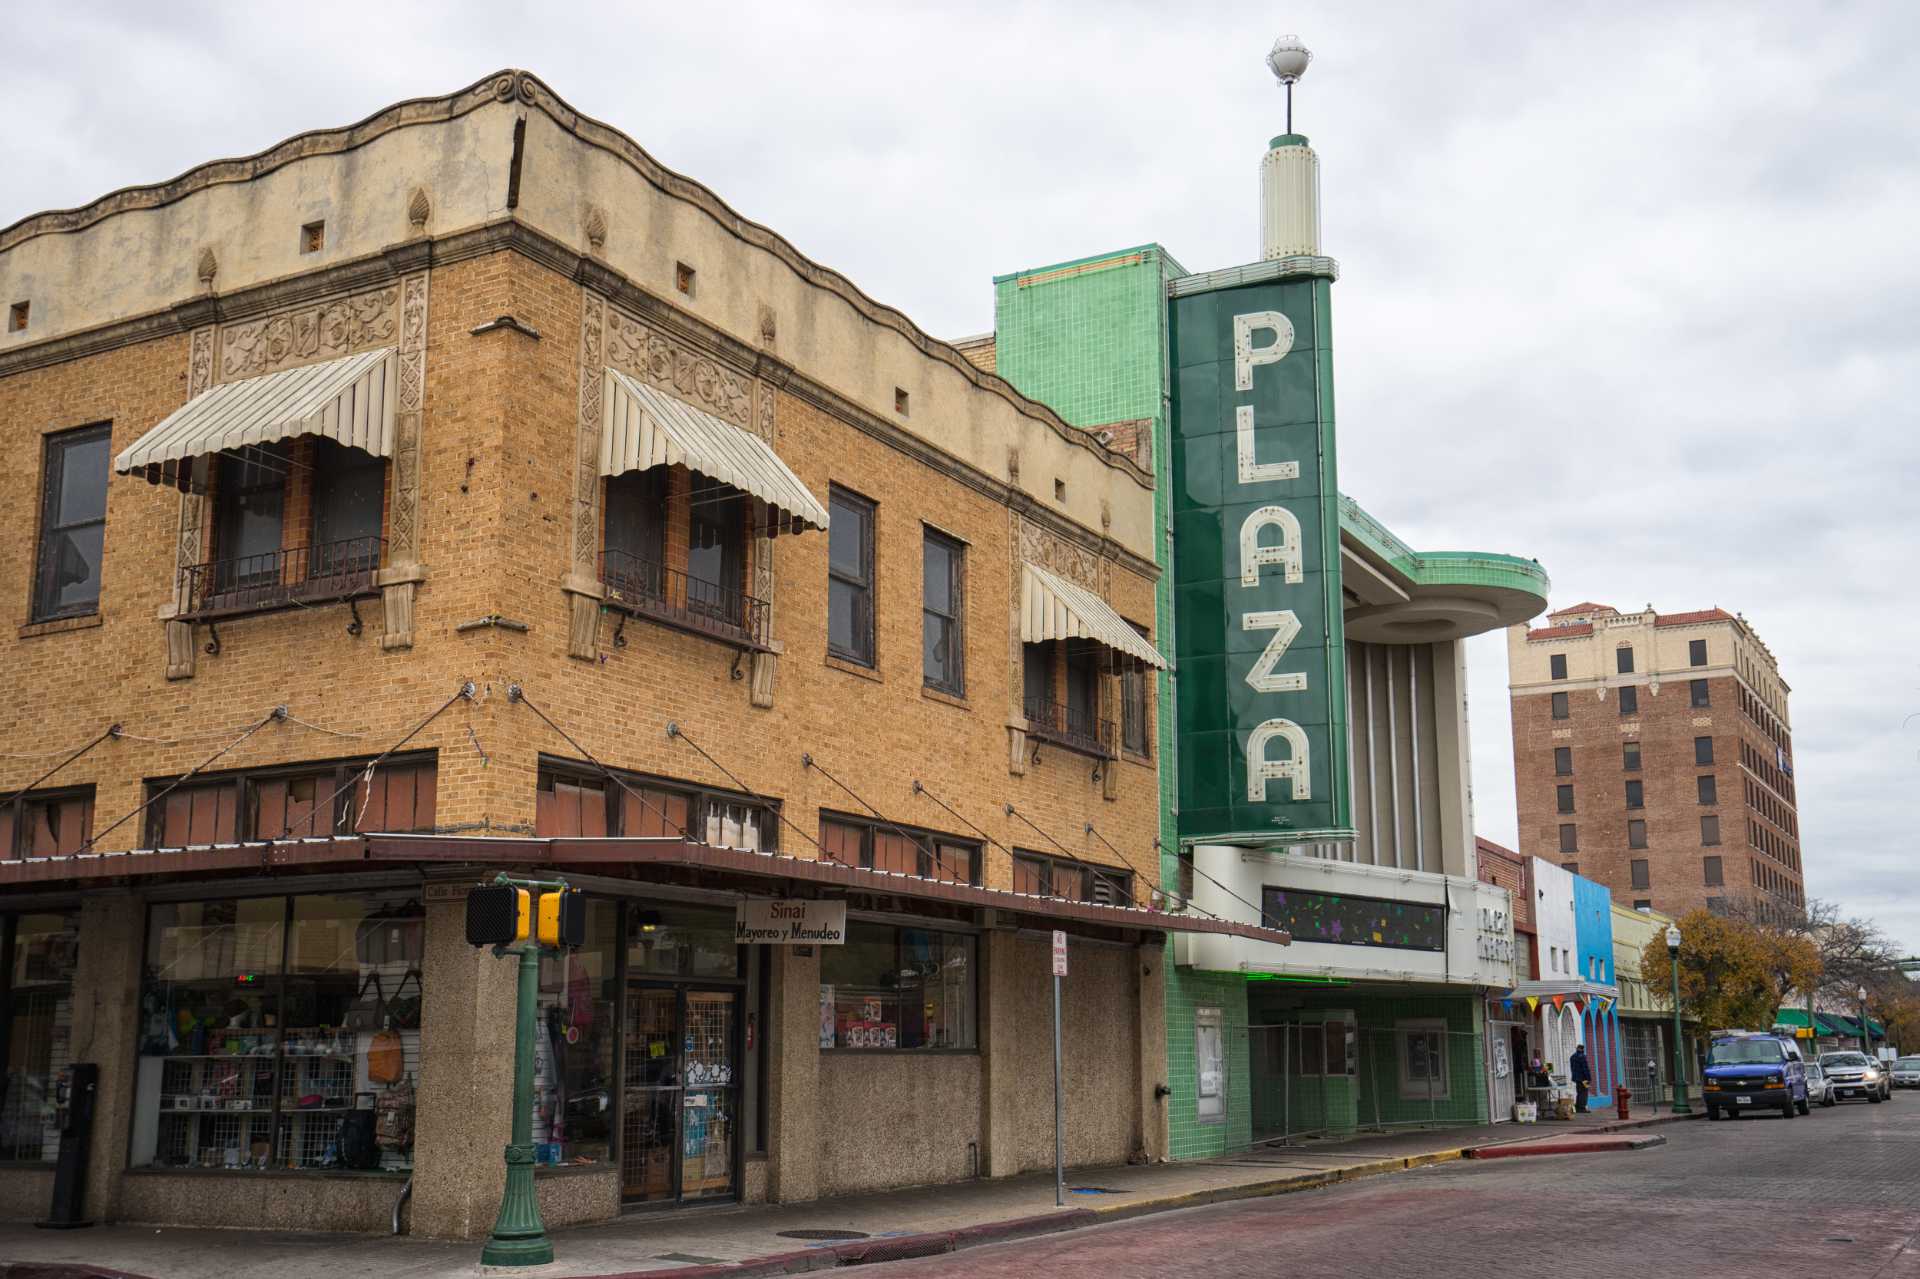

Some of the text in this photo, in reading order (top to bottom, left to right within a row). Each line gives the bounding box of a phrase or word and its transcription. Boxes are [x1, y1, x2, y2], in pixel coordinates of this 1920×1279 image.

[1232, 310, 1312, 801] PLAZA
[769, 901, 806, 919] Sinai
[736, 921, 840, 942] Mayoreo y Menudeo
